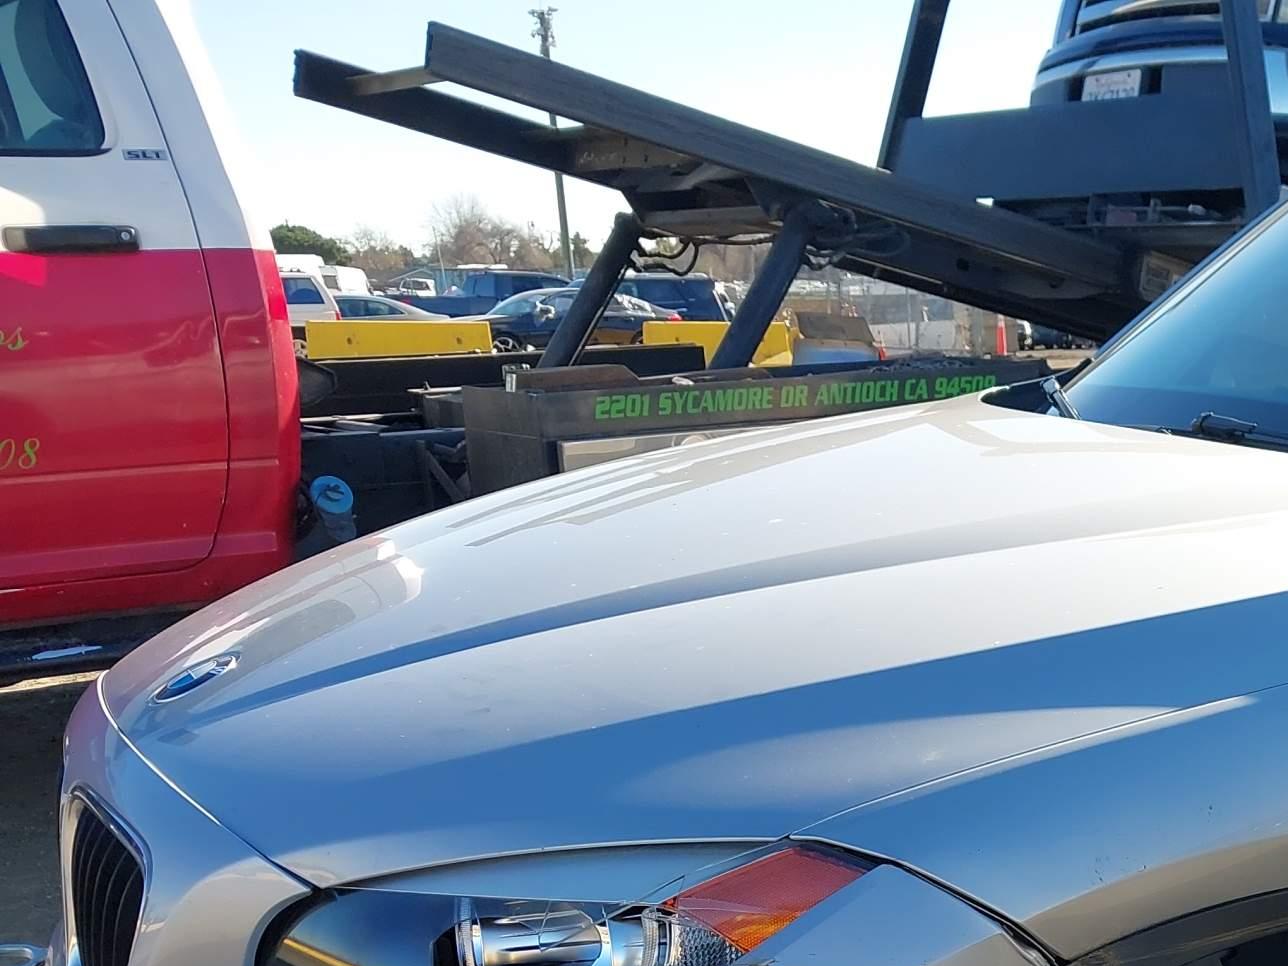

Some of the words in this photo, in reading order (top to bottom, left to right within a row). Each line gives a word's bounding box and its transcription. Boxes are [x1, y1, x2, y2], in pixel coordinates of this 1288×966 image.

[127, 150, 162, 160] SLT
[595, 393, 650, 419] 2201
[657, 387, 773, 416] SYCAMORE
[815, 380, 899, 405] ANTIOCH
[904, 377, 928, 401] CA
